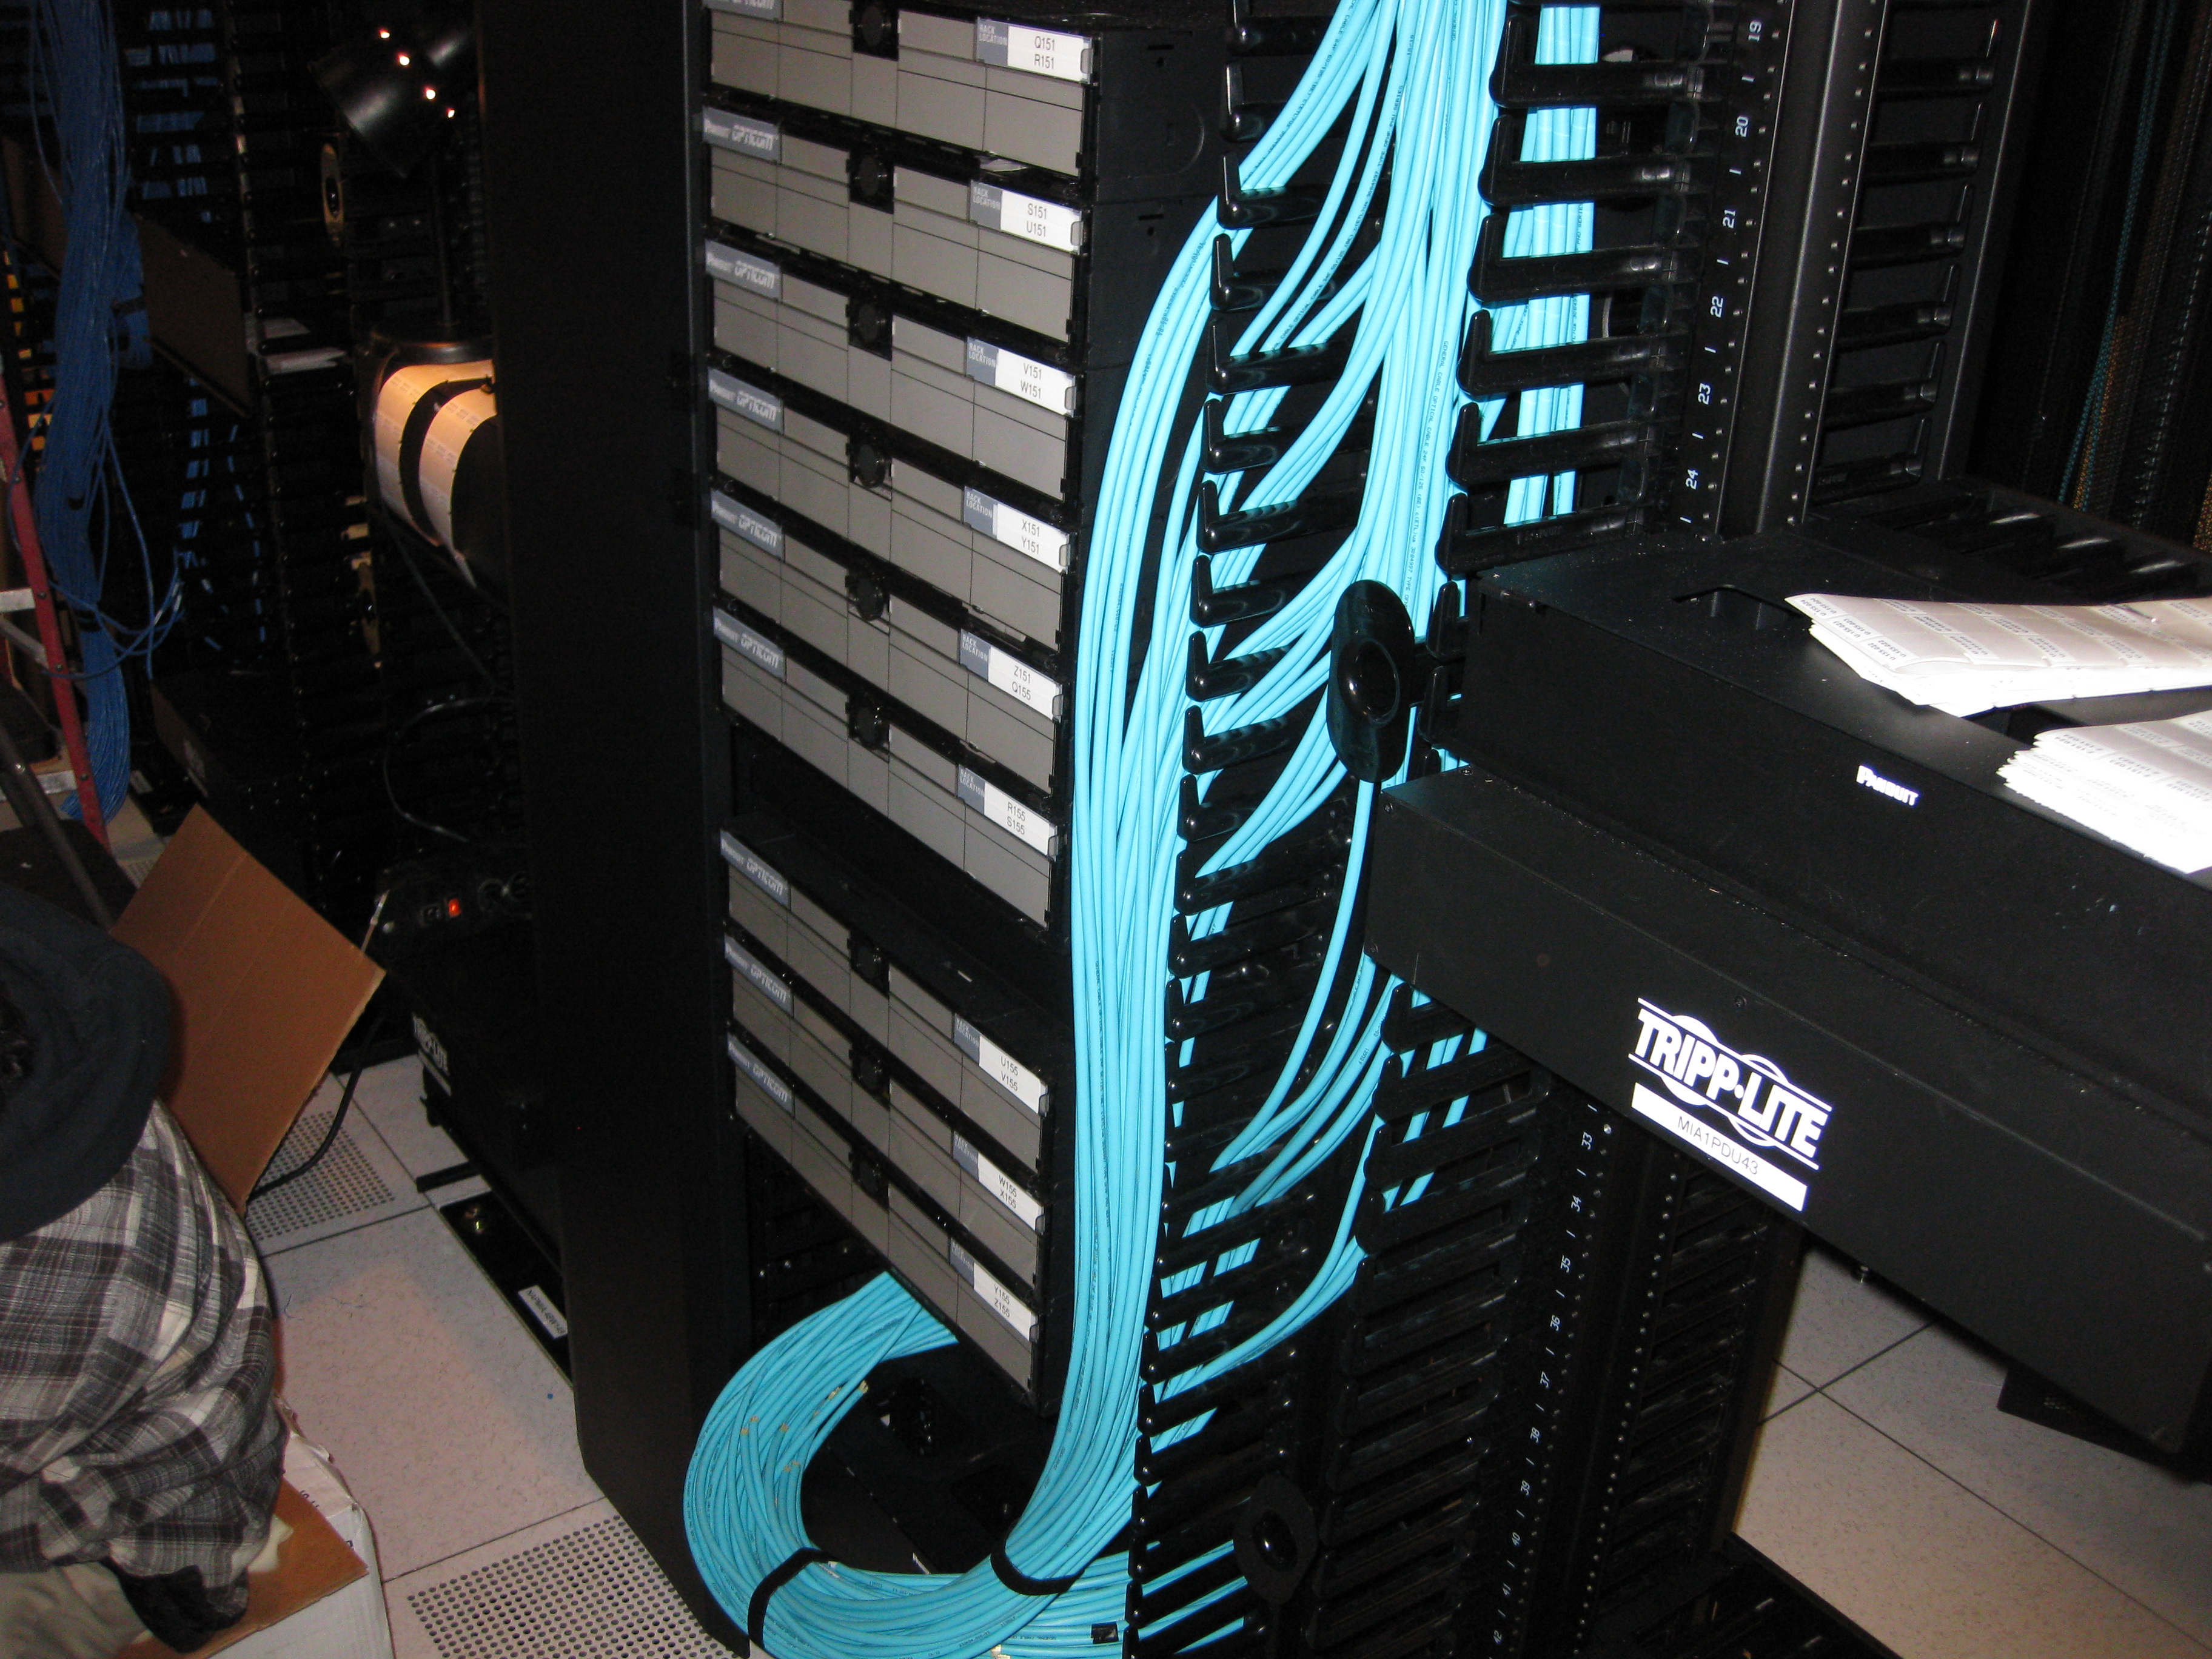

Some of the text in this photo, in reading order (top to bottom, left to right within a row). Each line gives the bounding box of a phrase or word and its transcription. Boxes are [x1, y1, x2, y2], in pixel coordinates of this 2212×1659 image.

[1748, 21, 1761, 42] 19
[1034, 36, 1054, 52] Q151
[1034, 53, 1054, 70] R151
[1735, 116, 1749, 137] 20
[1027, 203, 1047, 220] S151
[1723, 209, 1735, 228] 21
[1026, 221, 1046, 237] U151
[1711, 297, 1723, 317] 22
[969, 343, 984, 354] RACK
[968, 351, 996, 368] LOCATION
[1023, 363, 1042, 380] V151
[1020, 380, 1041, 400] W151
[1698, 383, 1711, 404] 23
[1428, 395, 1438, 423] OPTICAL
[1686, 470, 1698, 490] 24
[966, 492, 981, 504] RACK
[965, 500, 993, 518] LOCATION
[1021, 519, 1040, 537] X151
[1021, 536, 1039, 555] Y151
[962, 634, 977, 648] RACK
[962, 643, 988, 662] LOCATION
[1013, 665, 1031, 684] Z151
[1011, 682, 1031, 700] Q155
[1007, 802, 1026, 822] R155
[1007, 816, 1025, 836] S155
[1000, 1056, 1019, 1076] U155
[1000, 1070, 1019, 1091] V155
[1581, 1132, 1592, 1150] 33
[1678, 1115, 1758, 1175] MIA1PDU43
[999, 1174, 1017, 1198] W155
[1000, 1190, 1017, 1209] X155
[1570, 1195, 1582, 1213] 34
[1561, 1255, 1570, 1273] 35
[994, 1284, 1010, 1304] Y155
[994, 1298, 1010, 1318] Z155
[1550, 1315, 1560, 1332] 36
[1540, 1372, 1550, 1389] 37
[1530, 1427, 1540, 1443] 38
[1521, 1480, 1529, 1496] 39
[1511, 1532, 1521, 1546] 40
